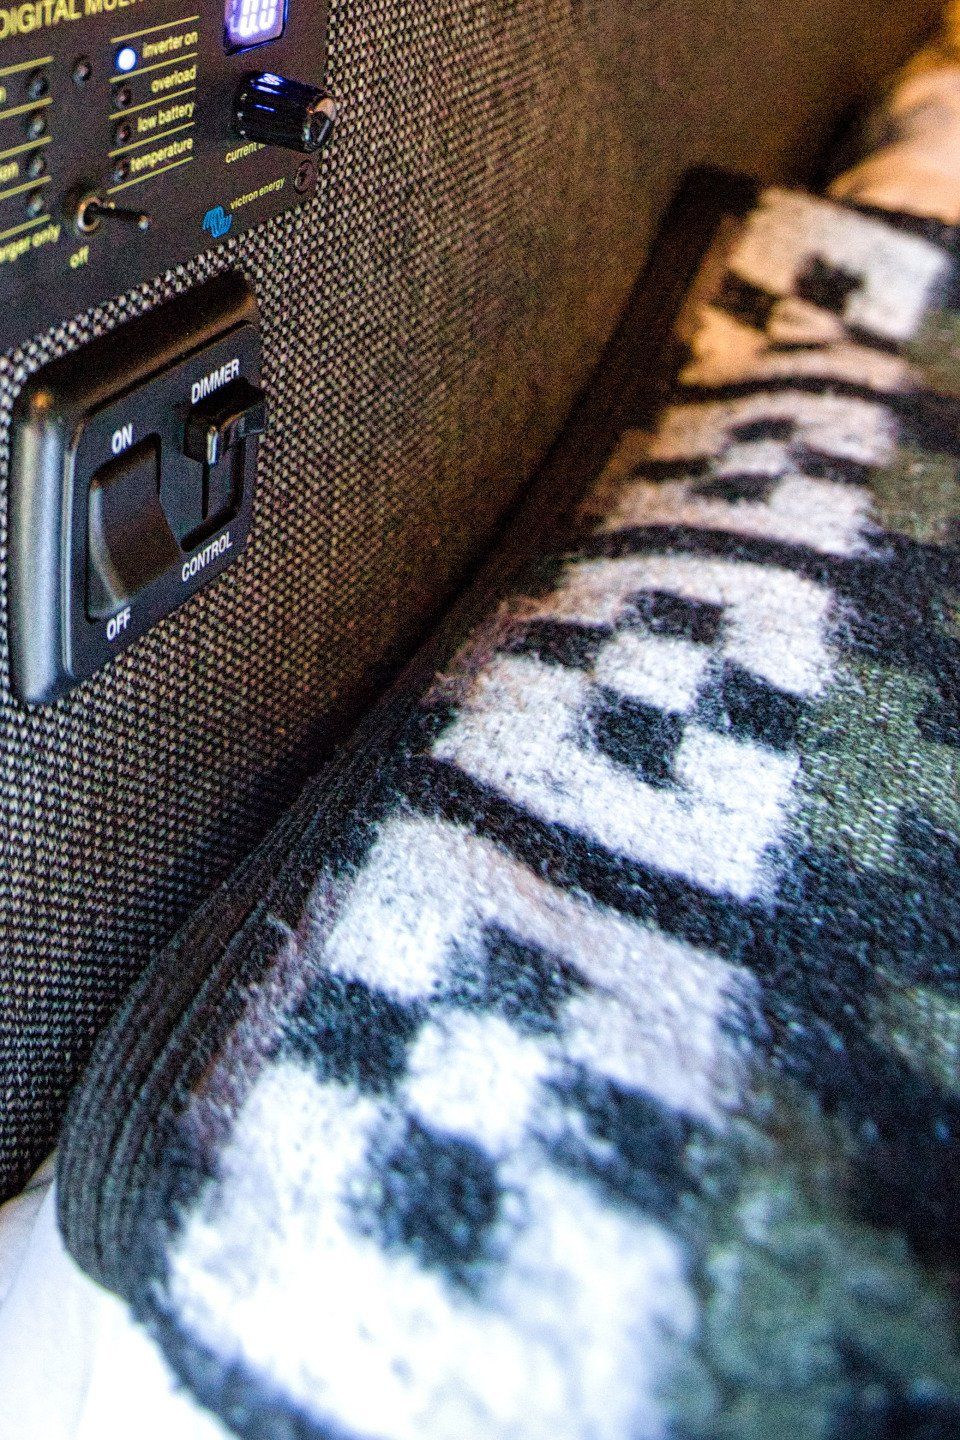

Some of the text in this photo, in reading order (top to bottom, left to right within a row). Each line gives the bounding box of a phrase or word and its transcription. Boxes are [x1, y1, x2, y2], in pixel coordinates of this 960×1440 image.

[142, 31, 198, 59] inverter on
[151, 64, 197, 93] overload
[137, 101, 195, 132] low battery
[130, 138, 194, 172] temperature
[225, 142, 258, 163] current
[230, 176, 286, 210] victron energy
[31, 223, 61, 247] only
[69, 244, 89, 269] off
[191, 358, 240, 404] DIMMER
[111, 423, 133, 456] ON
[181, 531, 233, 582] CONTROL
[106, 606, 132, 641] OFF
